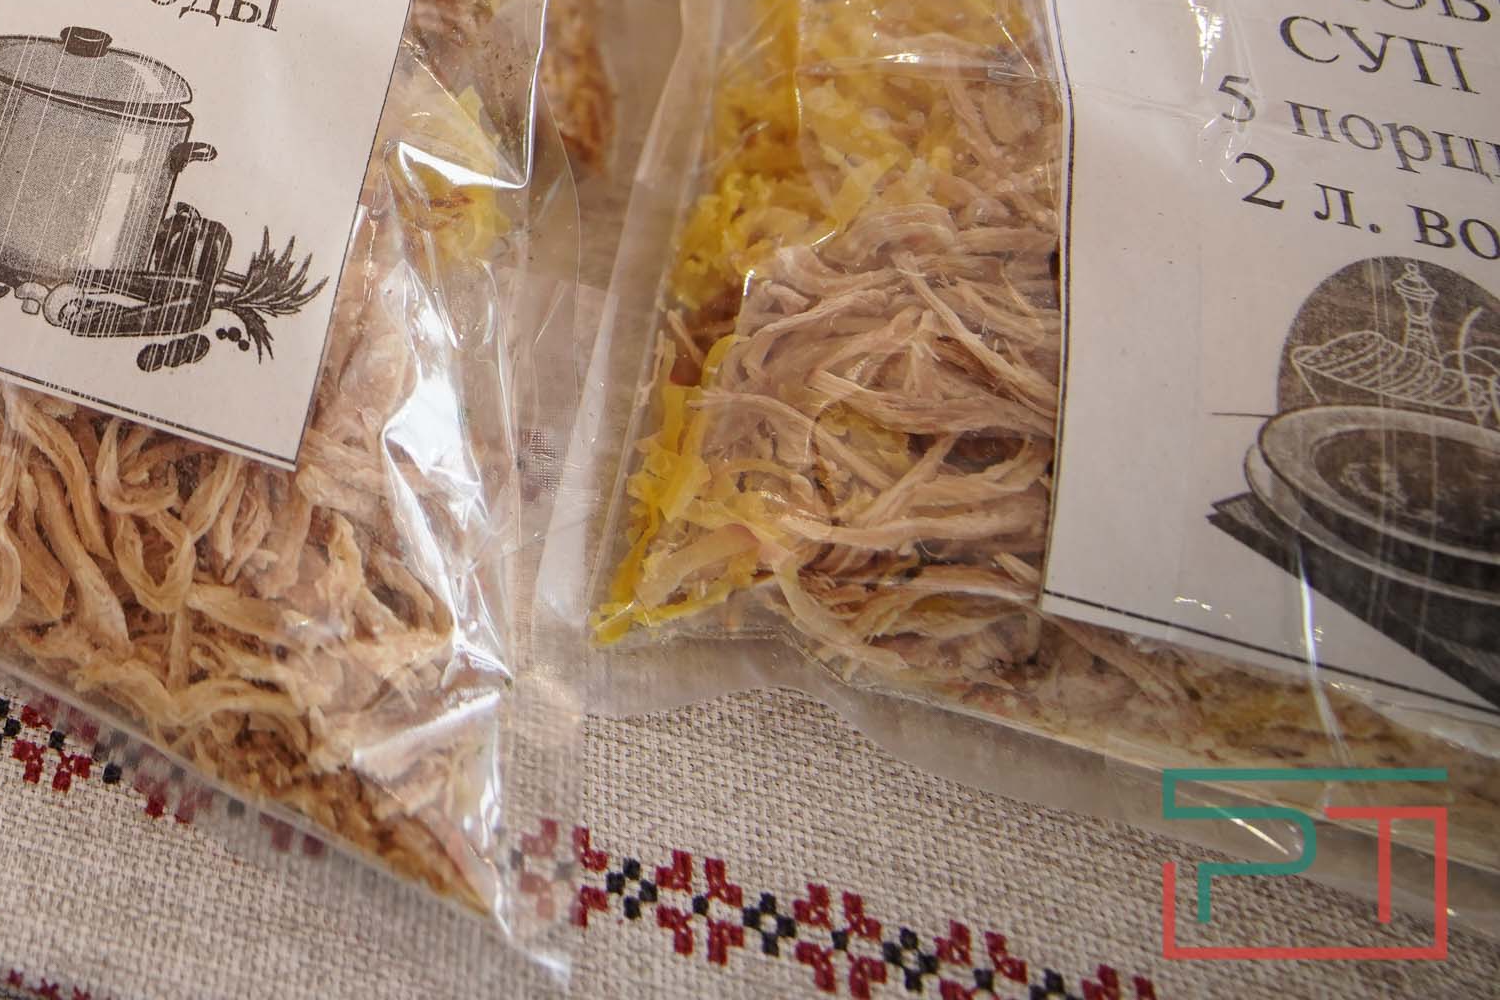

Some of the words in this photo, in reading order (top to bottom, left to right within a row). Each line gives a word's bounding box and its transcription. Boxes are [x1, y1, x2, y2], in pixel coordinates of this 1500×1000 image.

[1280, 16, 1480, 94] СУП
[1218, 75, 1255, 122] 5
[1284, 101, 1500, 183] порц
[1235, 153, 1284, 210] 2
[1314, 183, 1380, 234] л.
